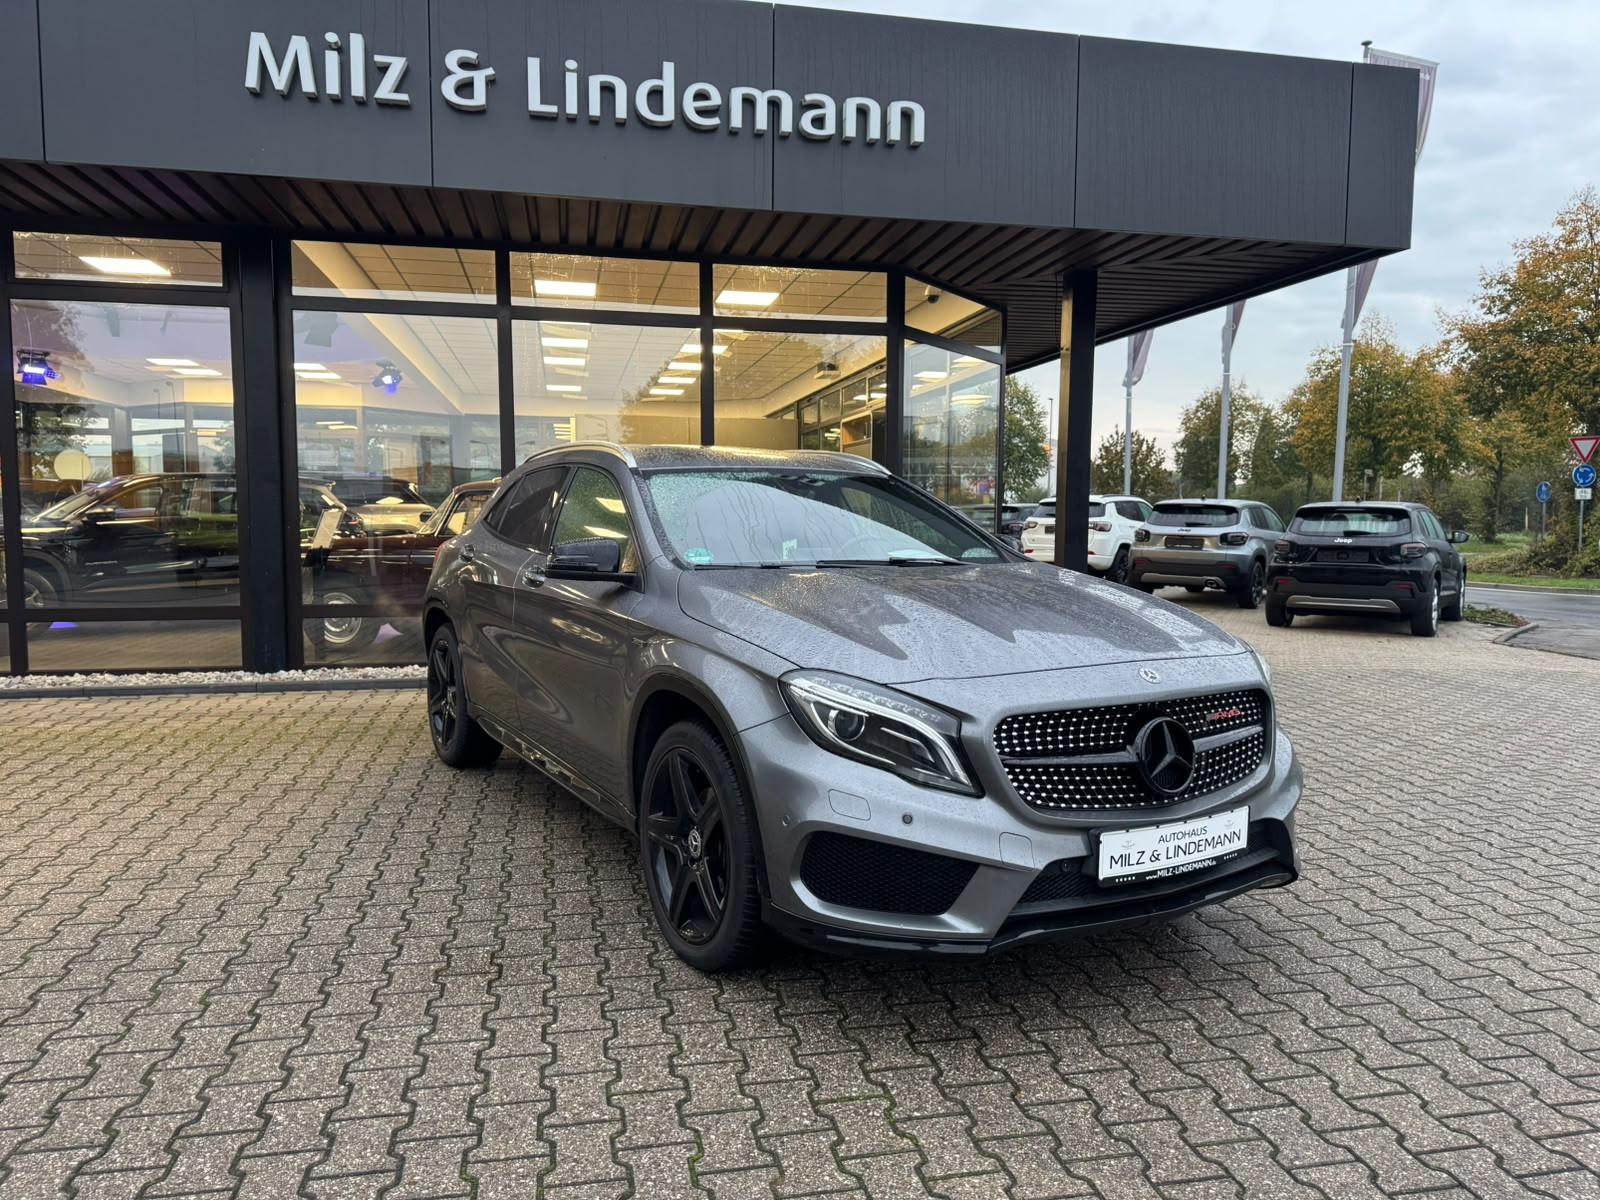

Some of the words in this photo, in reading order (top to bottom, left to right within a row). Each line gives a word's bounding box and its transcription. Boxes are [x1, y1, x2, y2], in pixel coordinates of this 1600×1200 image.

[244, 31, 411, 106] Milz
[440, 48, 497, 112] &
[526, 56, 926, 147] Lindemann
[1109, 850, 1146, 870] MILZ
[1149, 849, 1161, 863] &
[1166, 828, 1242, 860] LINDEMANN
[1158, 825, 1208, 844] AUTOHAUS
